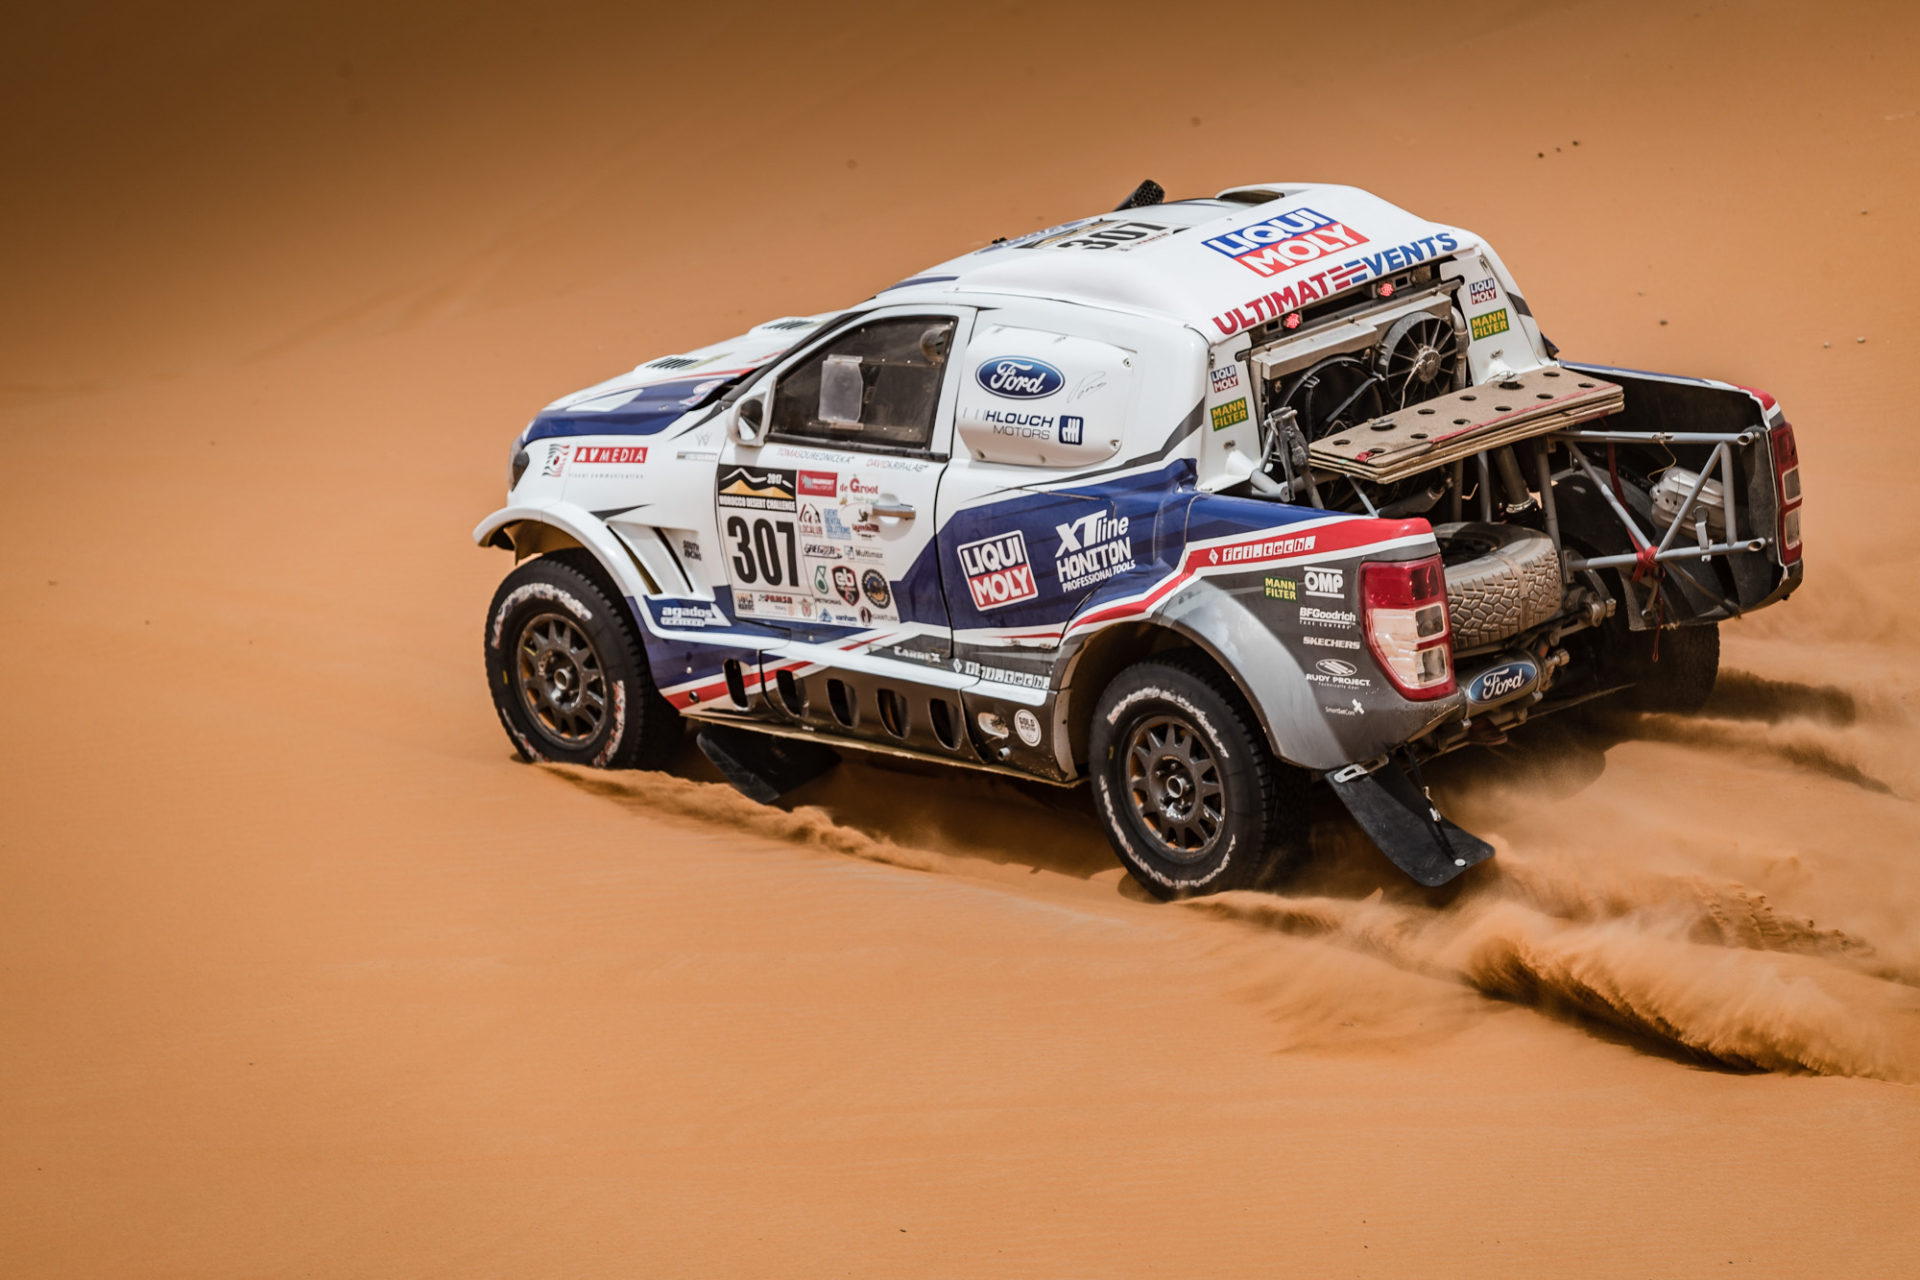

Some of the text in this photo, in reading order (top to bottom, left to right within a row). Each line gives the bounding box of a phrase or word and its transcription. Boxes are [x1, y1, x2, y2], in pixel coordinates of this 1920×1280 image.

[1057, 222, 1168, 250] 307
[1206, 209, 1330, 253] LIQUI
[1242, 224, 1351, 275] MOLY
[1471, 278, 1495, 293] LIQUI
[1472, 289, 1496, 304] MOLY
[1472, 310, 1506, 328] MANN
[1474, 320, 1508, 339] FILTER
[990, 361, 1046, 393] Ford
[1211, 365, 1236, 382] LIQUI
[1213, 376, 1238, 393] MOLY
[1212, 399, 1246, 419] MANN
[985, 411, 1054, 428] HLOUCH
[1214, 410, 1247, 429] FILTER
[993, 425, 1050, 440] MOTORS
[767, 473, 782, 484] 2017
[840, 484, 848, 492] de
[850, 477, 879, 494] Groot
[766, 498, 796, 512] CHALLENGE
[727, 516, 799, 587] 307
[962, 536, 1024, 576] LIQUI
[1056, 536, 1132, 583] HONITON
[1061, 559, 1137, 593] PROFESSIONAL TOOLS
[1265, 578, 1296, 591] MANN
[1304, 572, 1343, 593] OMP
[972, 566, 1029, 606] MOLY
[1266, 588, 1296, 600] FILTER
[662, 606, 713, 618] agados
[1300, 607, 1356, 622] BFGoodrich
[1303, 636, 1360, 650] SKECHERS
[1306, 674, 1370, 686] RUDY PROJECT
[1483, 668, 1524, 699] Ford
